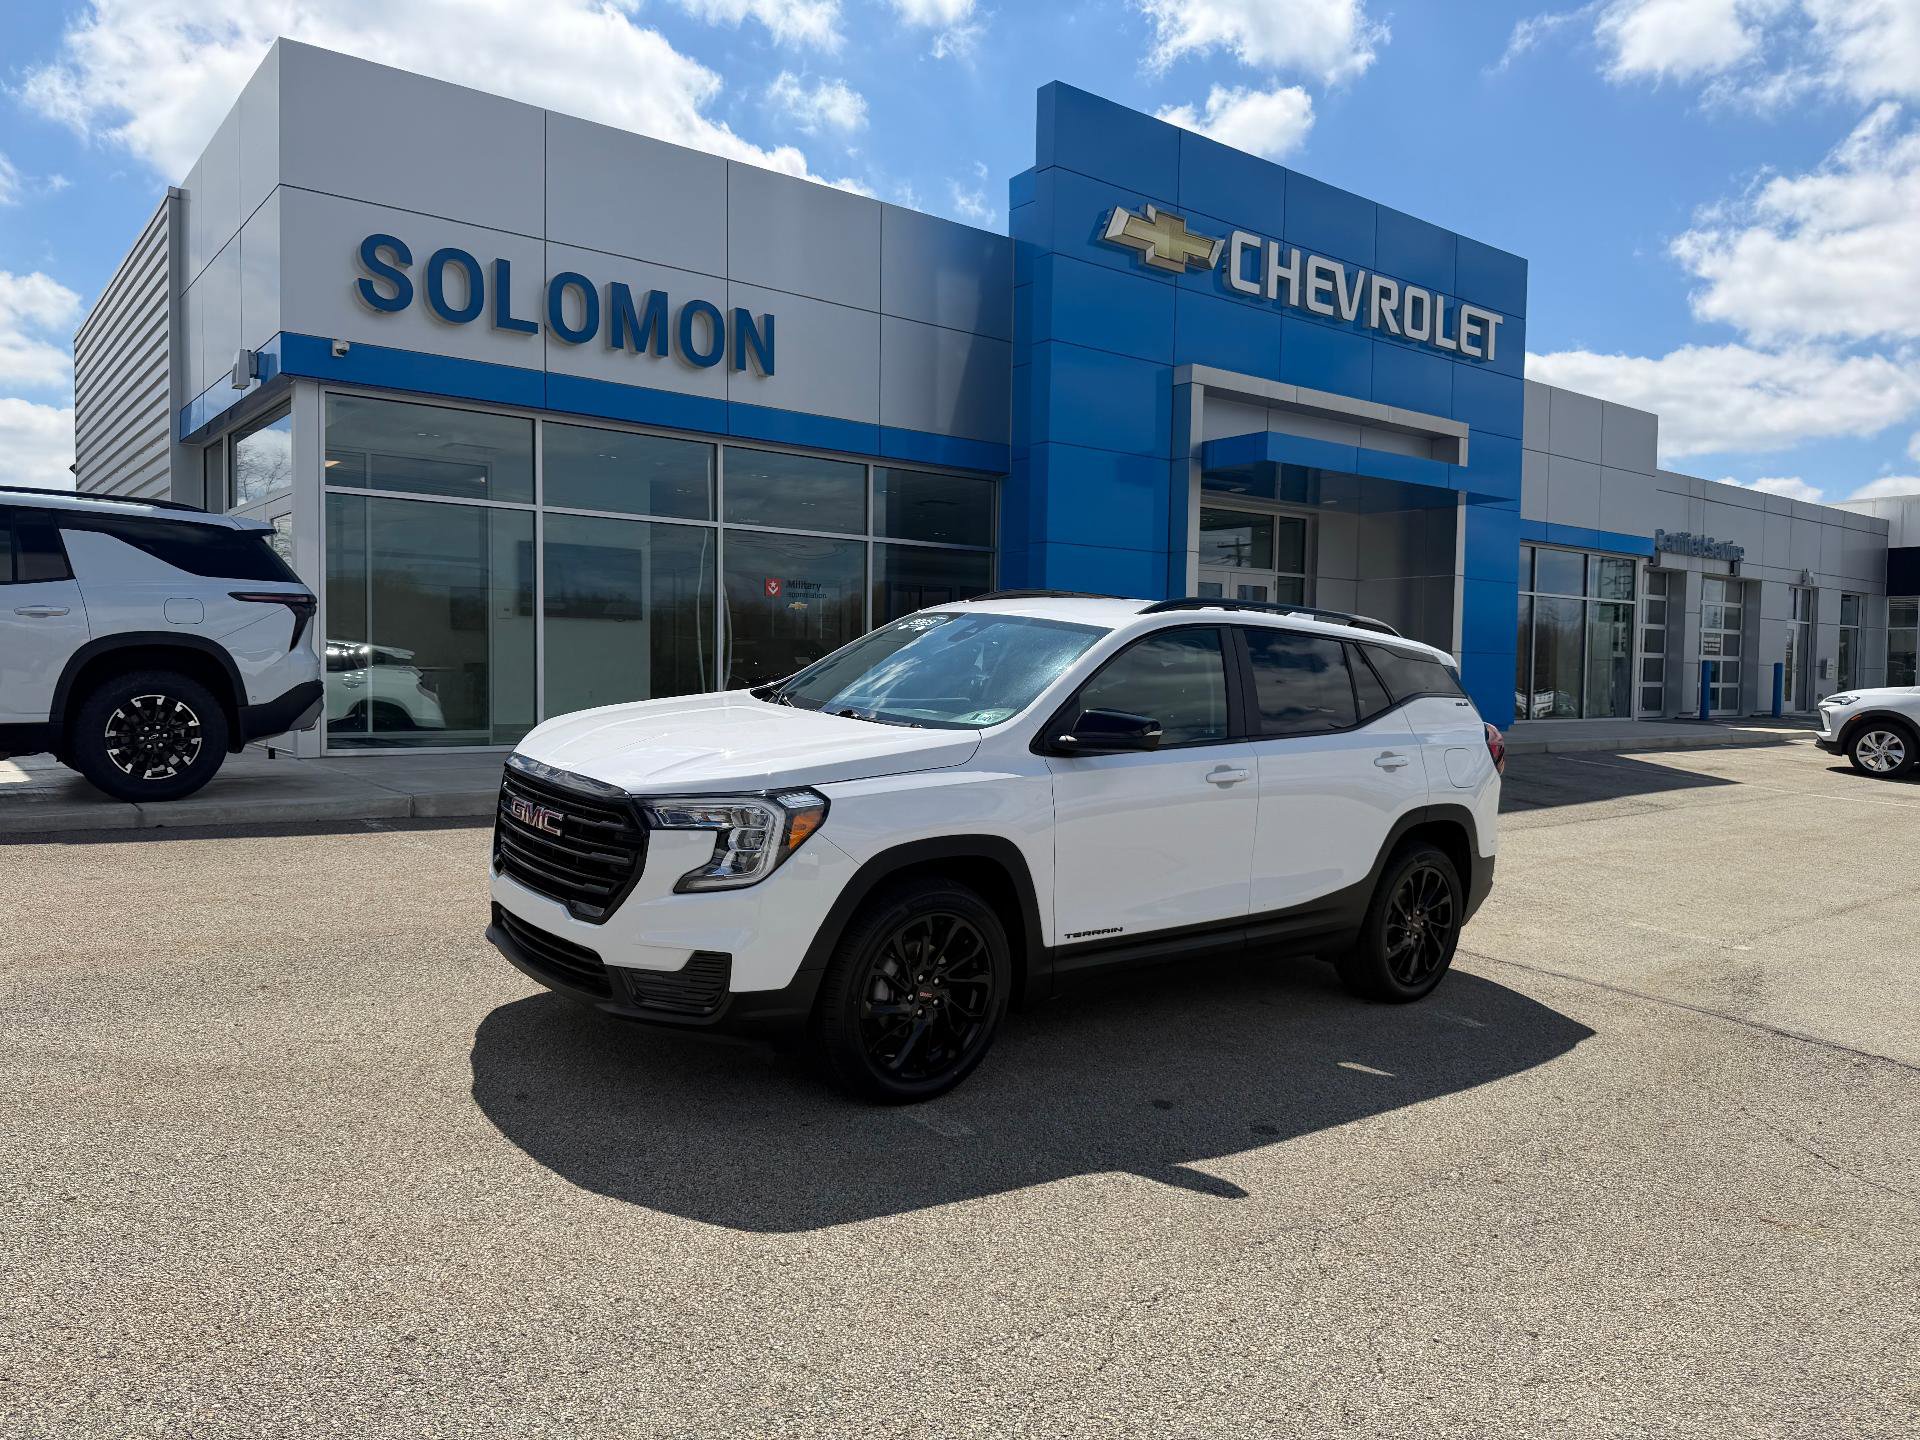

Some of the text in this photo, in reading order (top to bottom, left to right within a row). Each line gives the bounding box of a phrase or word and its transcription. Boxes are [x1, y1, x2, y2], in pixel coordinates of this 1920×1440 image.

[354, 233, 775, 377] SOLOMON
[1229, 230, 1504, 361] CHEVROLET
[786, 579, 821, 592] Military
[511, 797, 563, 837] GMC
[1064, 926, 1123, 939] TERRAIN
